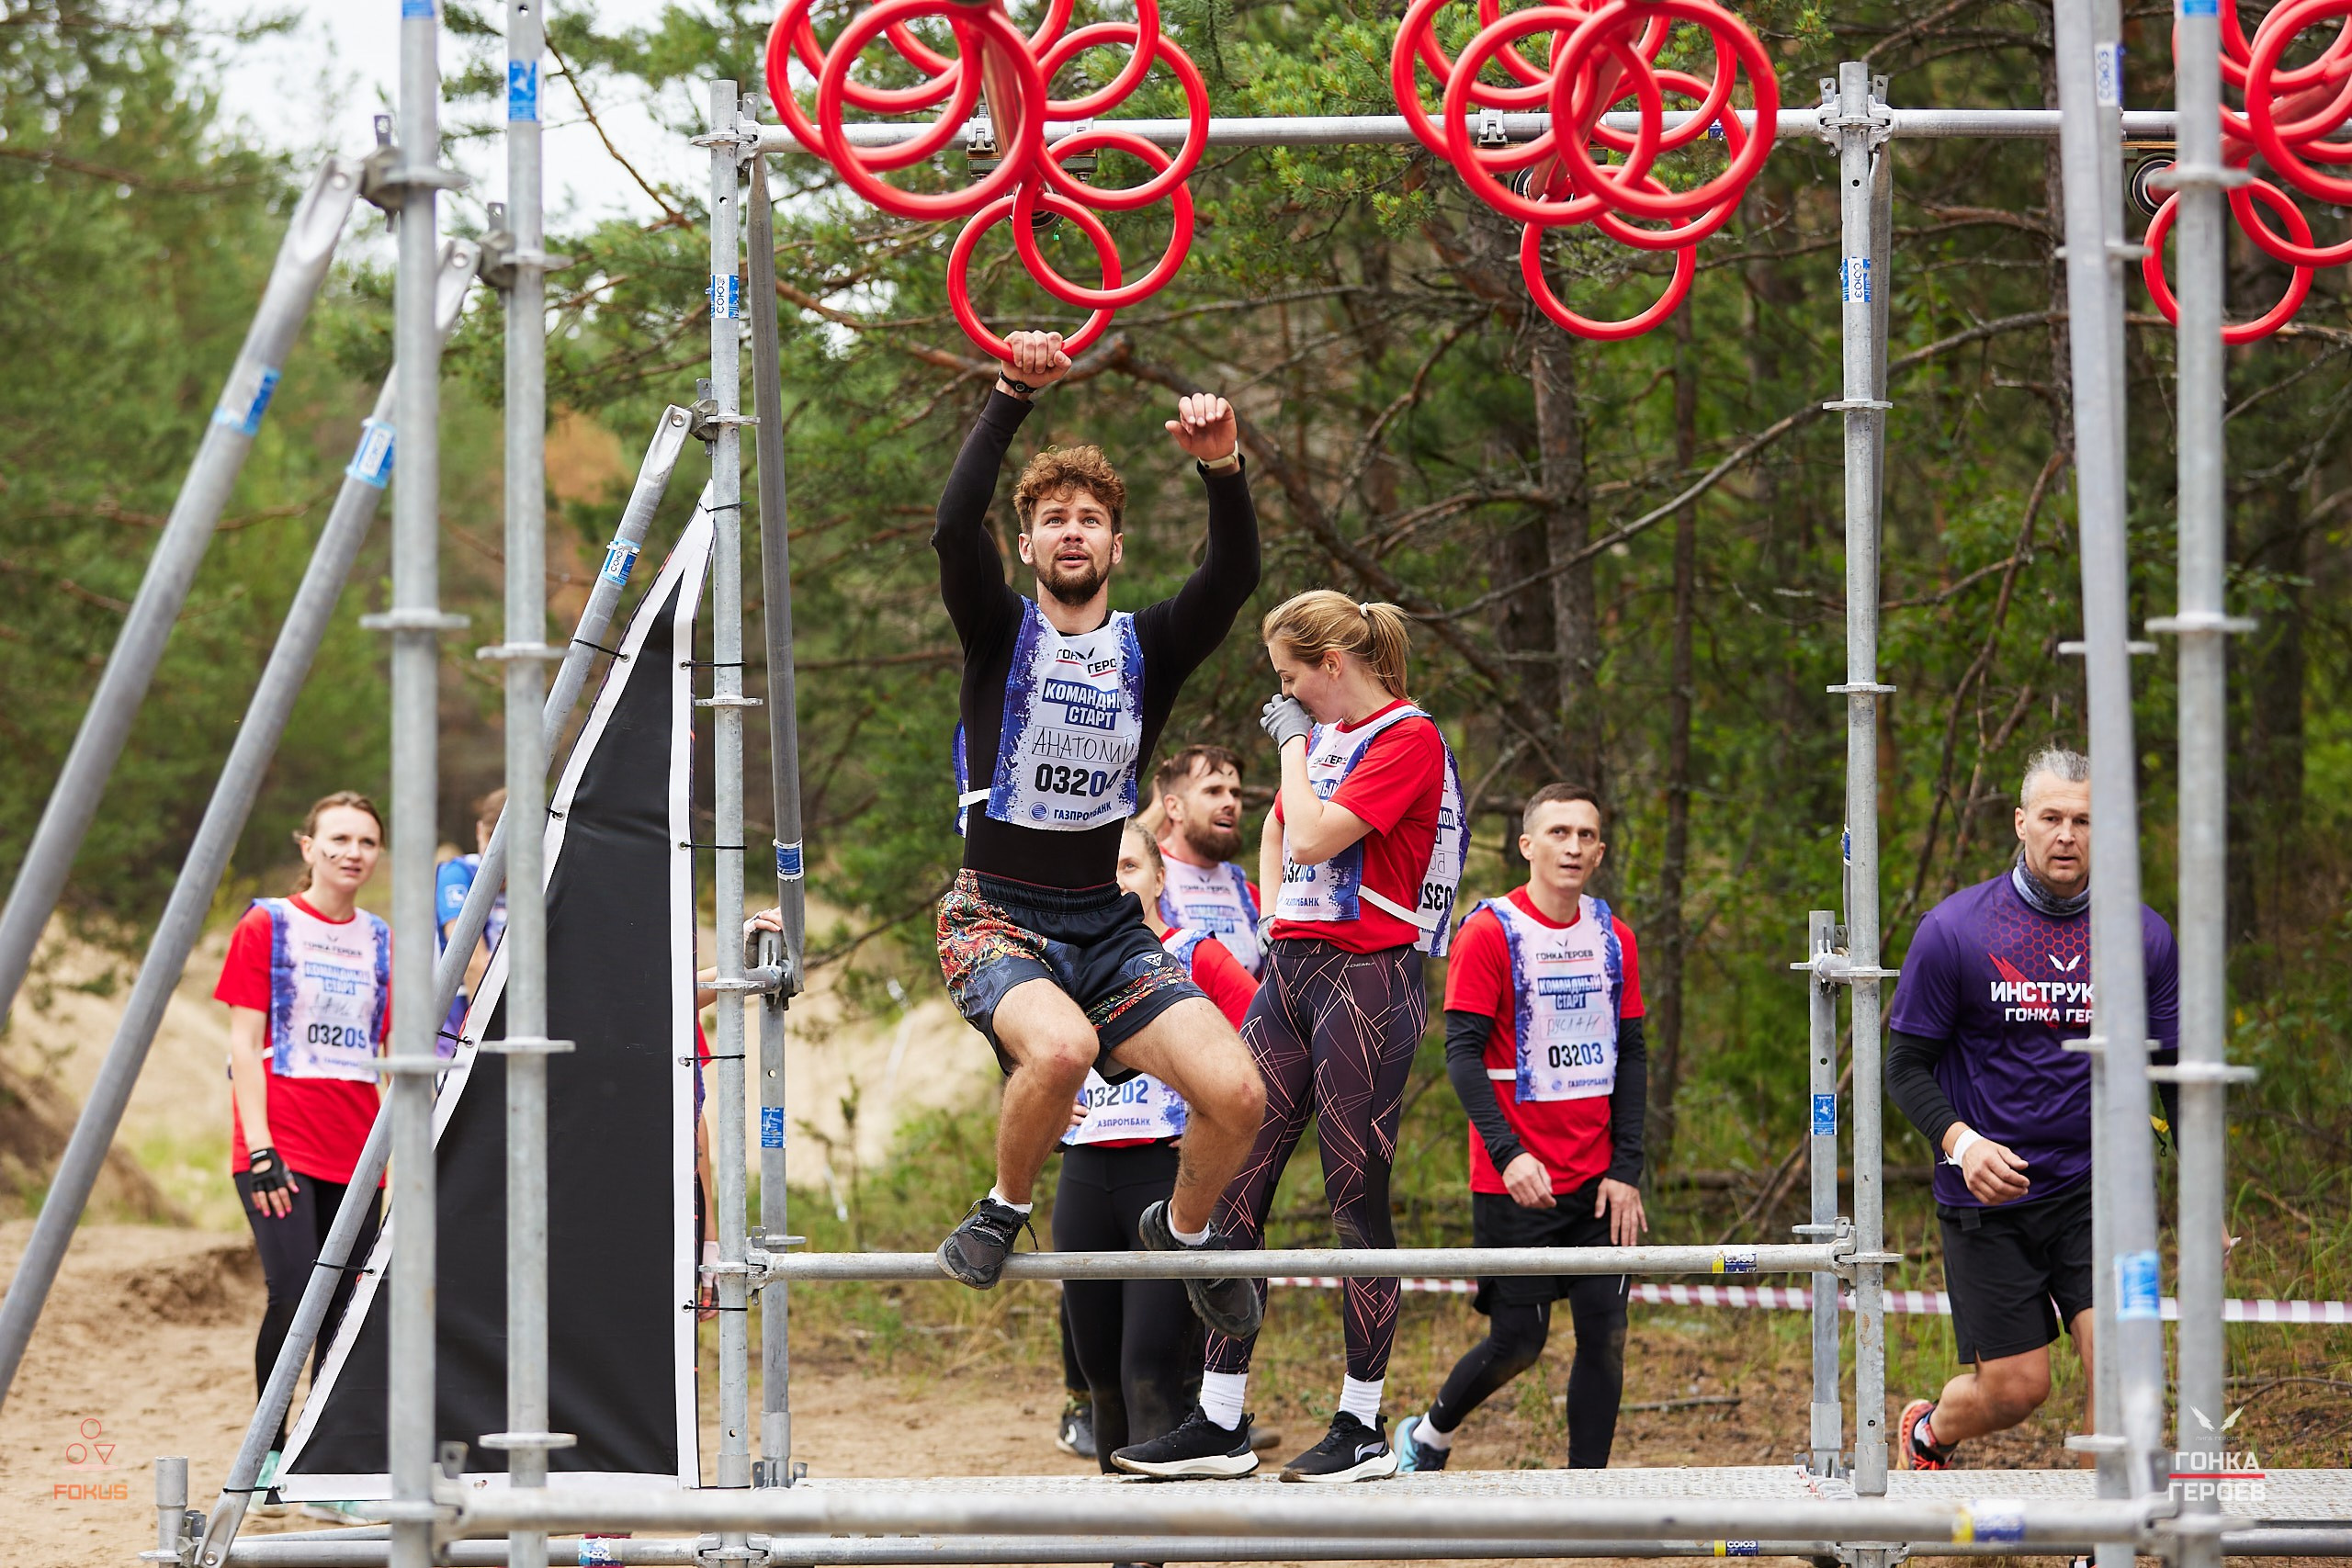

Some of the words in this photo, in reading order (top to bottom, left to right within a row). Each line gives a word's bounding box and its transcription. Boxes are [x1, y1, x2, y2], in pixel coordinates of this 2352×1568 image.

[1068, 705, 1114, 728] СТАРТ
[1035, 763, 1121, 797] 03204
[1054, 801, 1113, 821] ГАЗПРОМБАНК
[1536, 952, 1563, 960] ГОНКА
[1565, 949, 1594, 959] ГЕРОЕВ
[1540, 976, 1600, 995] КОМАНДНЫЙ
[1556, 994, 1585, 1010] СТАРТ
[2005, 1008, 2060, 1021] ГОНКА
[1548, 1043, 1603, 1068] 03203
